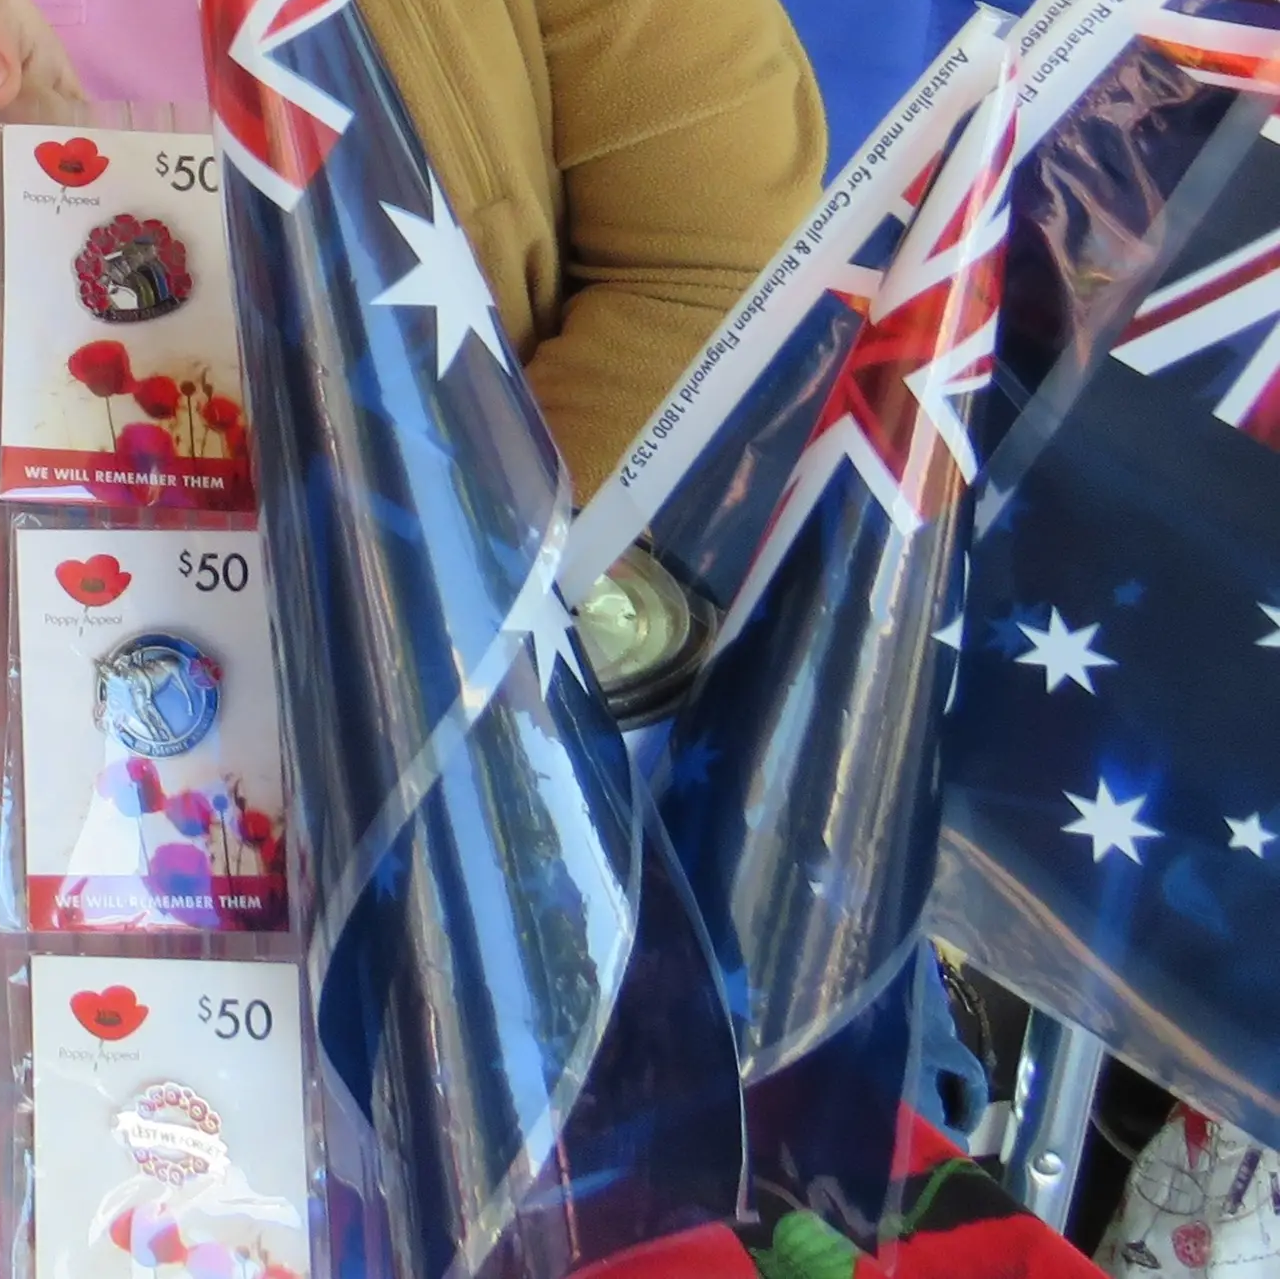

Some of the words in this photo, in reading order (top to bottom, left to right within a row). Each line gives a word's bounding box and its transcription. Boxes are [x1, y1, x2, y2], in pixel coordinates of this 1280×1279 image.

[1037, 7, 1112, 86] Richardson
[903, 47, 968, 122] Australian
[866, 122, 904, 165] made
[24, 192, 57, 204] Poppy
[61, 194, 100, 206] Appeal
[846, 166, 873, 192] for
[804, 190, 851, 245] Carroll
[795, 240, 812, 255] &
[735, 254, 800, 331] Richardson
[680, 329, 740, 405] Flagworld
[653, 397, 686, 440] 1800
[630, 440, 658, 469] 135
[25, 466, 49, 479] WE
[54, 467, 90, 482] WILL
[95, 470, 177, 486] REMEMBER
[182, 475, 224, 489] THEM
[179, 550, 249, 593] $50
[45, 613, 80, 625] Poppy
[83, 614, 122, 625] Appeal
[56, 895, 80, 909] WE
[87, 895, 125, 909] WILL
[130, 895, 213, 910] REMEMBER
[220, 896, 261, 910] THEM
[198, 995, 272, 1039] $50
